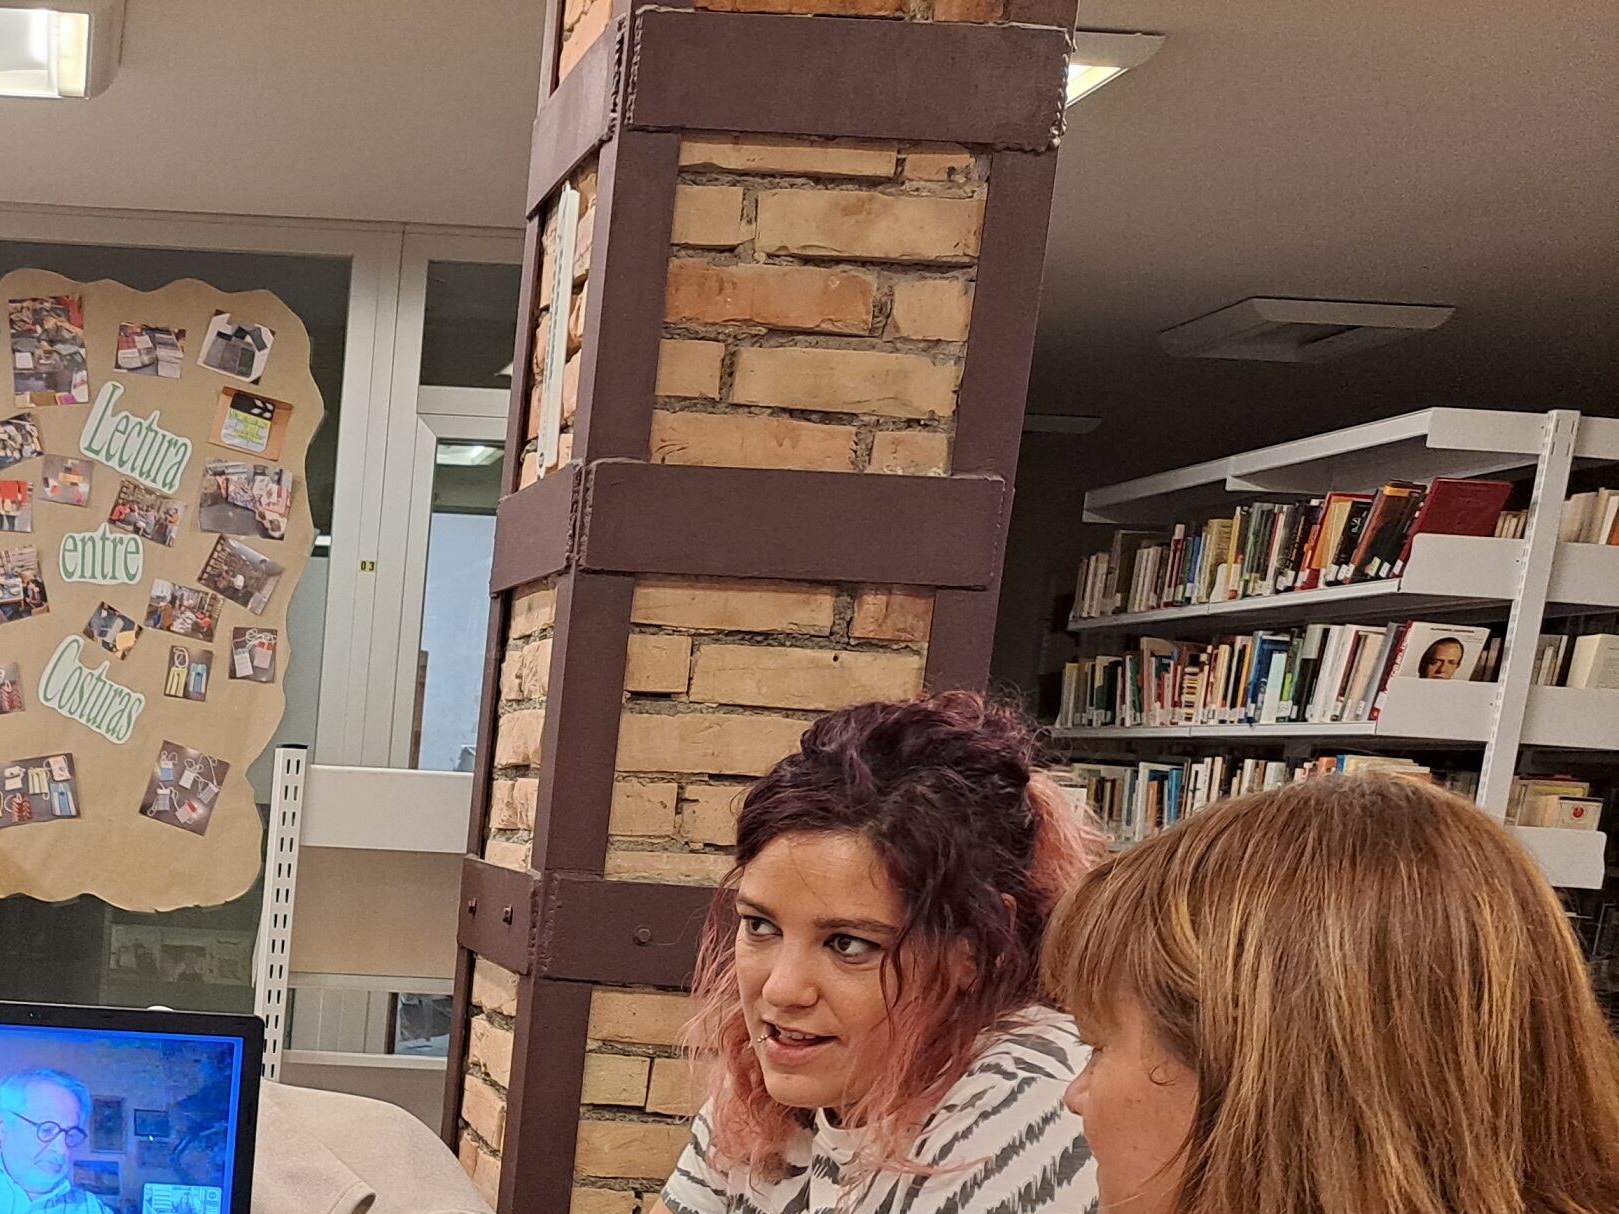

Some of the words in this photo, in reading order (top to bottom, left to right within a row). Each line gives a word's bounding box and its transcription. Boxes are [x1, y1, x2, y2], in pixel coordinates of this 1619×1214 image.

[84, 383, 188, 491] Lectura
[61, 527, 140, 582] entre
[42, 638, 142, 742] Costuras
